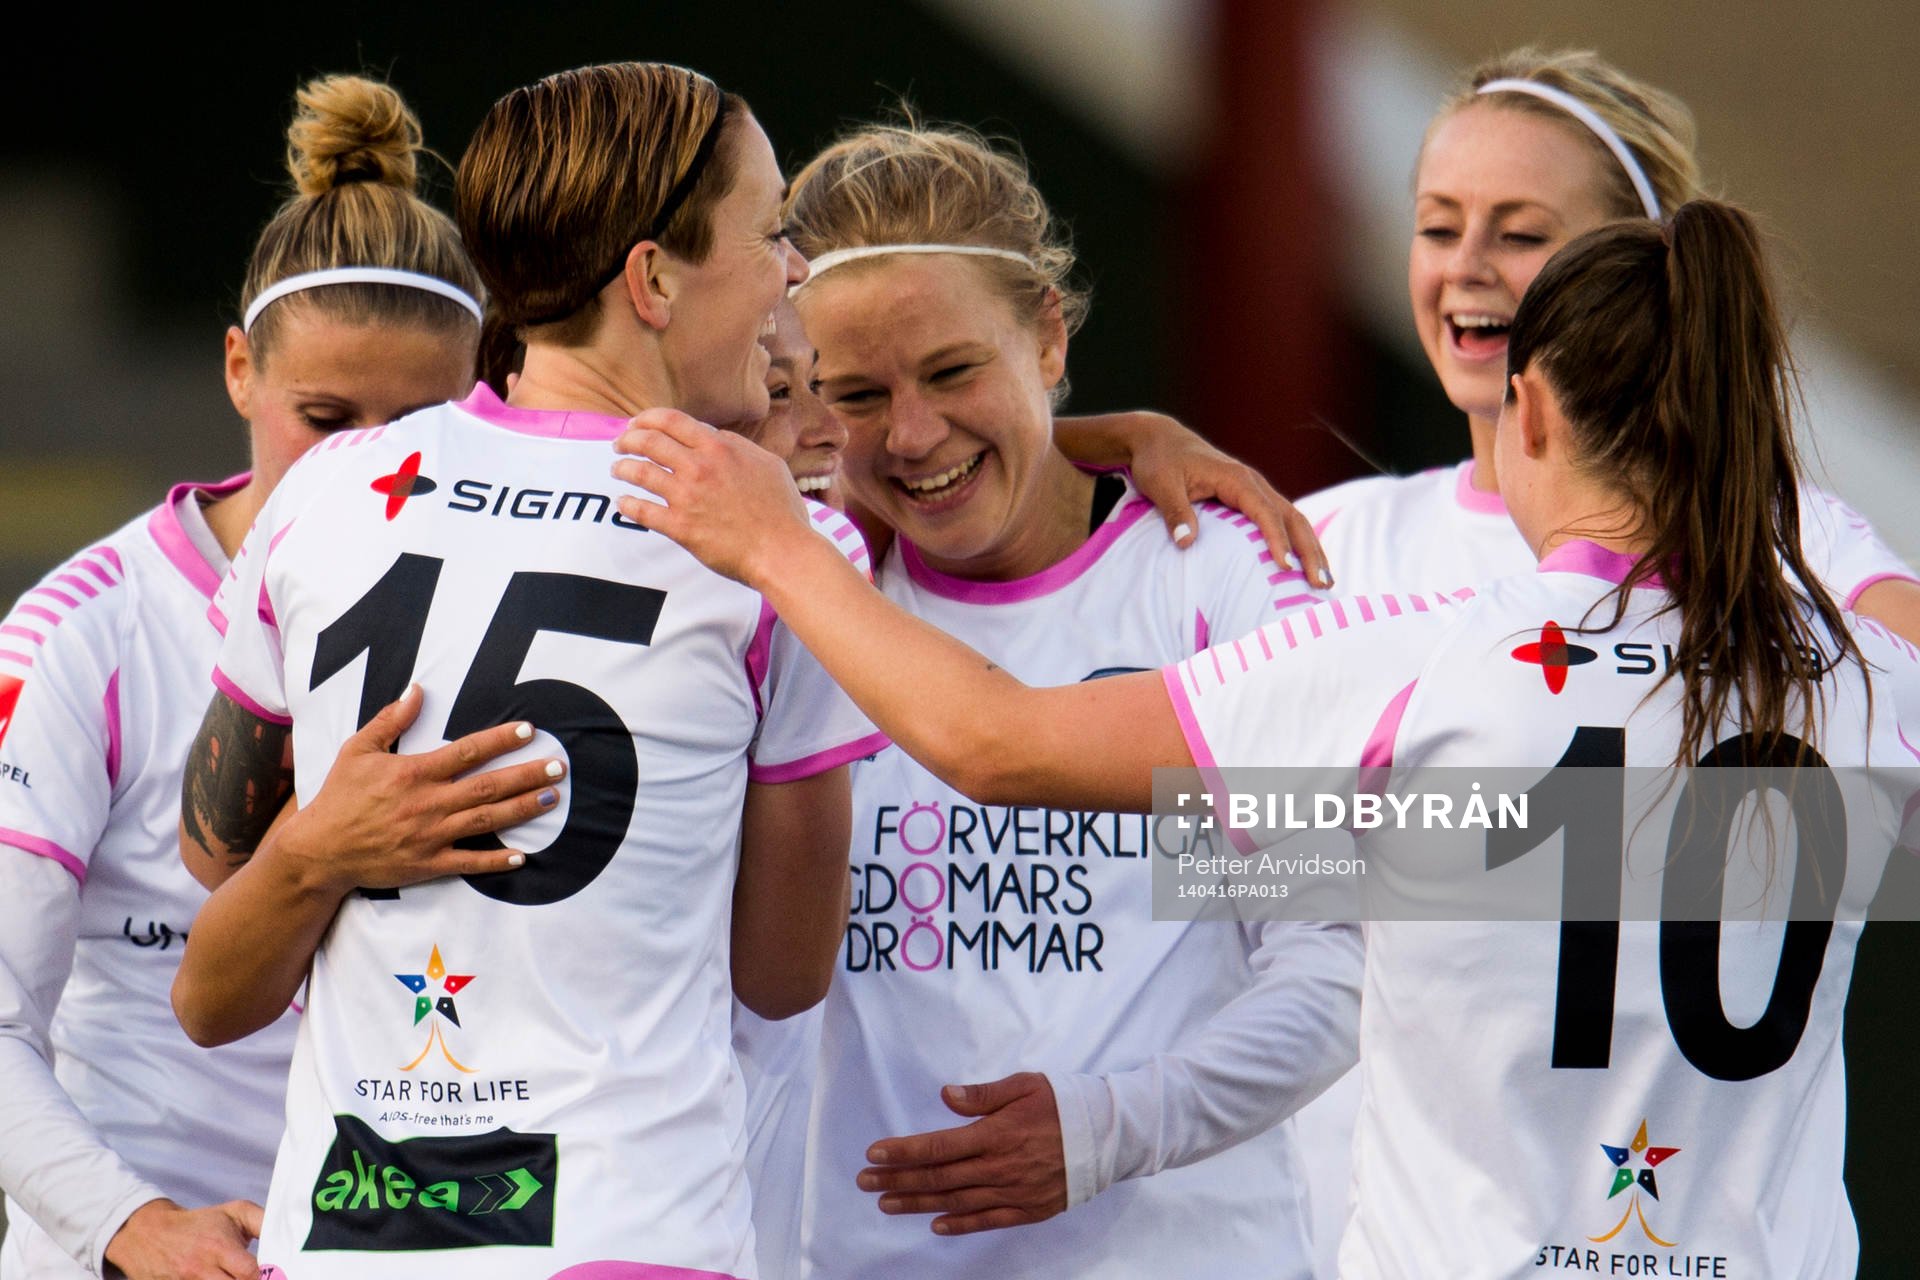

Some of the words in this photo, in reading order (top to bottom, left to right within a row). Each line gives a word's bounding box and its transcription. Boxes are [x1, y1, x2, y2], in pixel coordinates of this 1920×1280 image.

[309, 552, 667, 905] 15
[0, 761, 32, 789] PEL
[1485, 726, 1848, 1081] 10
[846, 915, 1104, 972] DRÖMMAR
[354, 1079, 412, 1101] STAR
[420, 1081, 463, 1102] FOR
[473, 1080, 530, 1102] LIFE
[379, 1111, 438, 1126] AIDS-free
[440, 1114, 472, 1126] that's
[475, 1115, 494, 1125] me
[315, 1150, 460, 1213] akea
[1535, 1245, 1600, 1272] STAR
[1610, 1254, 1658, 1276] FOR
[1669, 1255, 1727, 1278] LIFE
